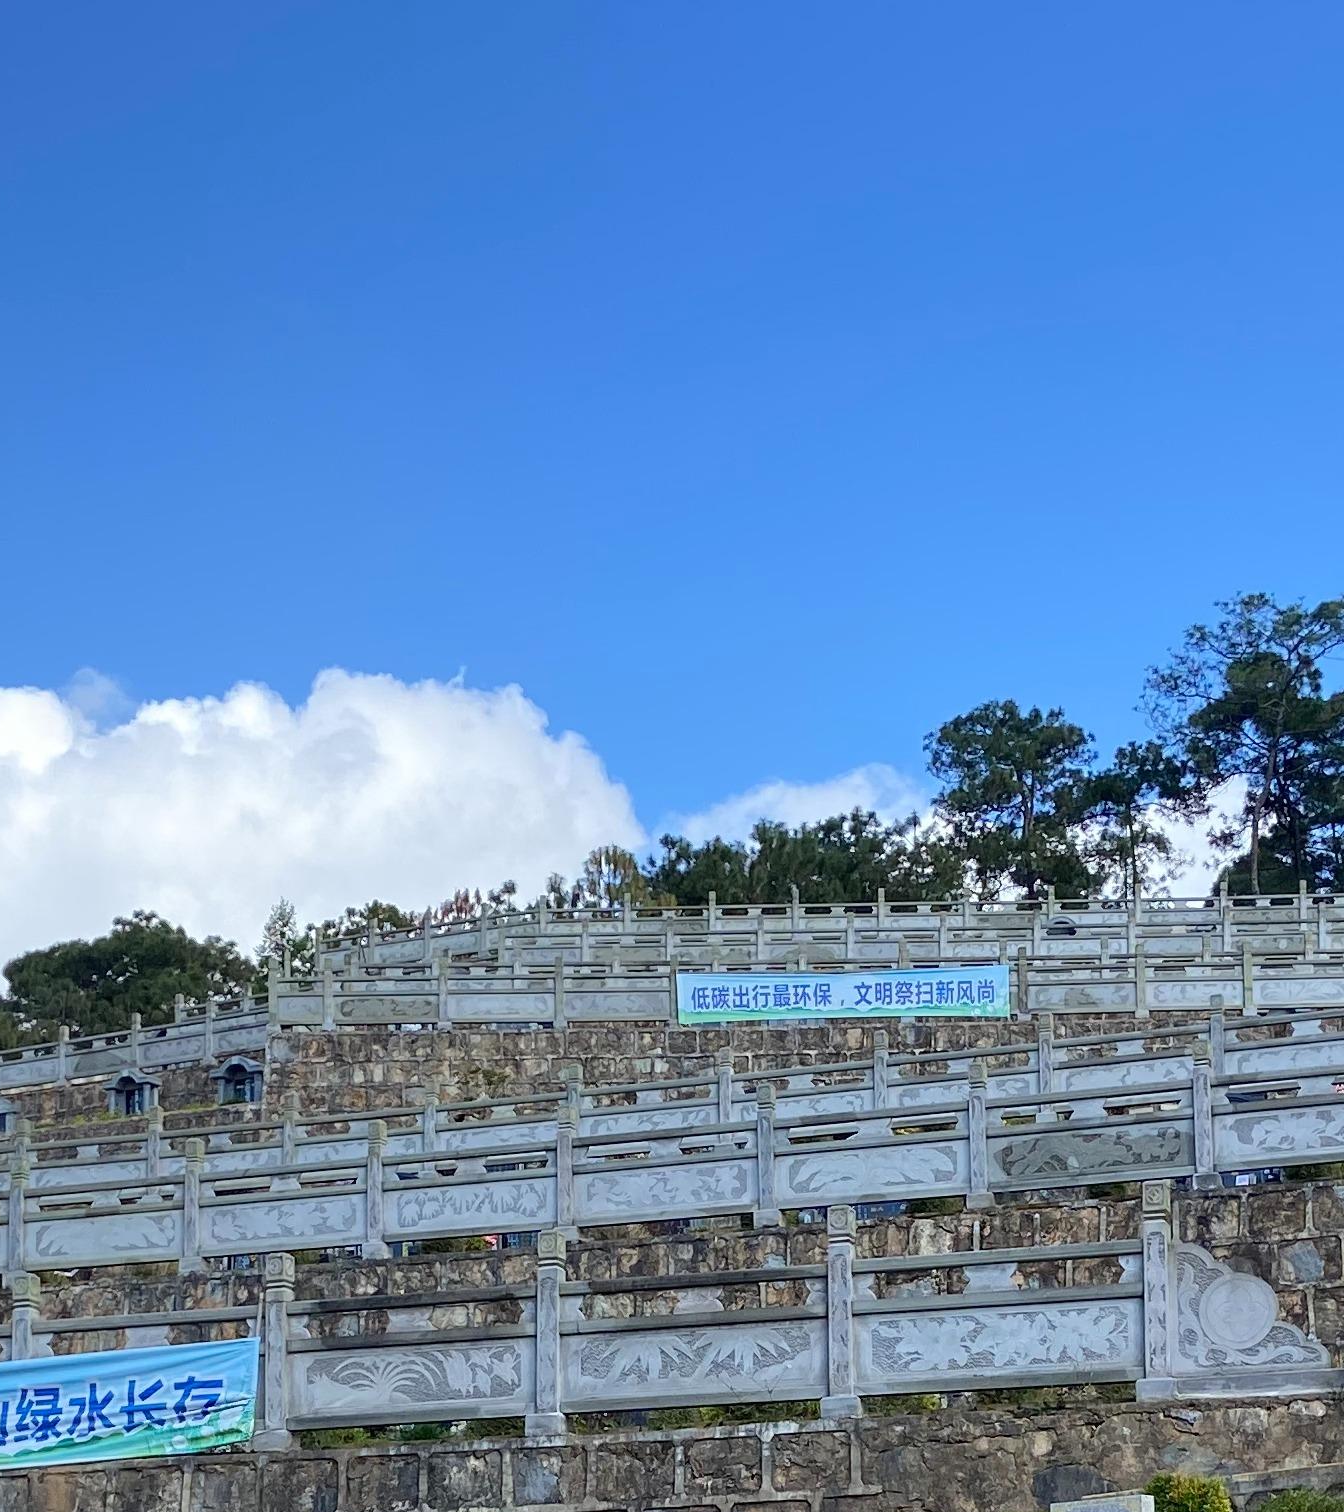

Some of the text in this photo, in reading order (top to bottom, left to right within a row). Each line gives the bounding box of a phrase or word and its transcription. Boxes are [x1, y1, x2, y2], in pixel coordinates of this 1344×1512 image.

[690, 979, 996, 1011] 低碳出行最环保，文明祭扫新风尚
